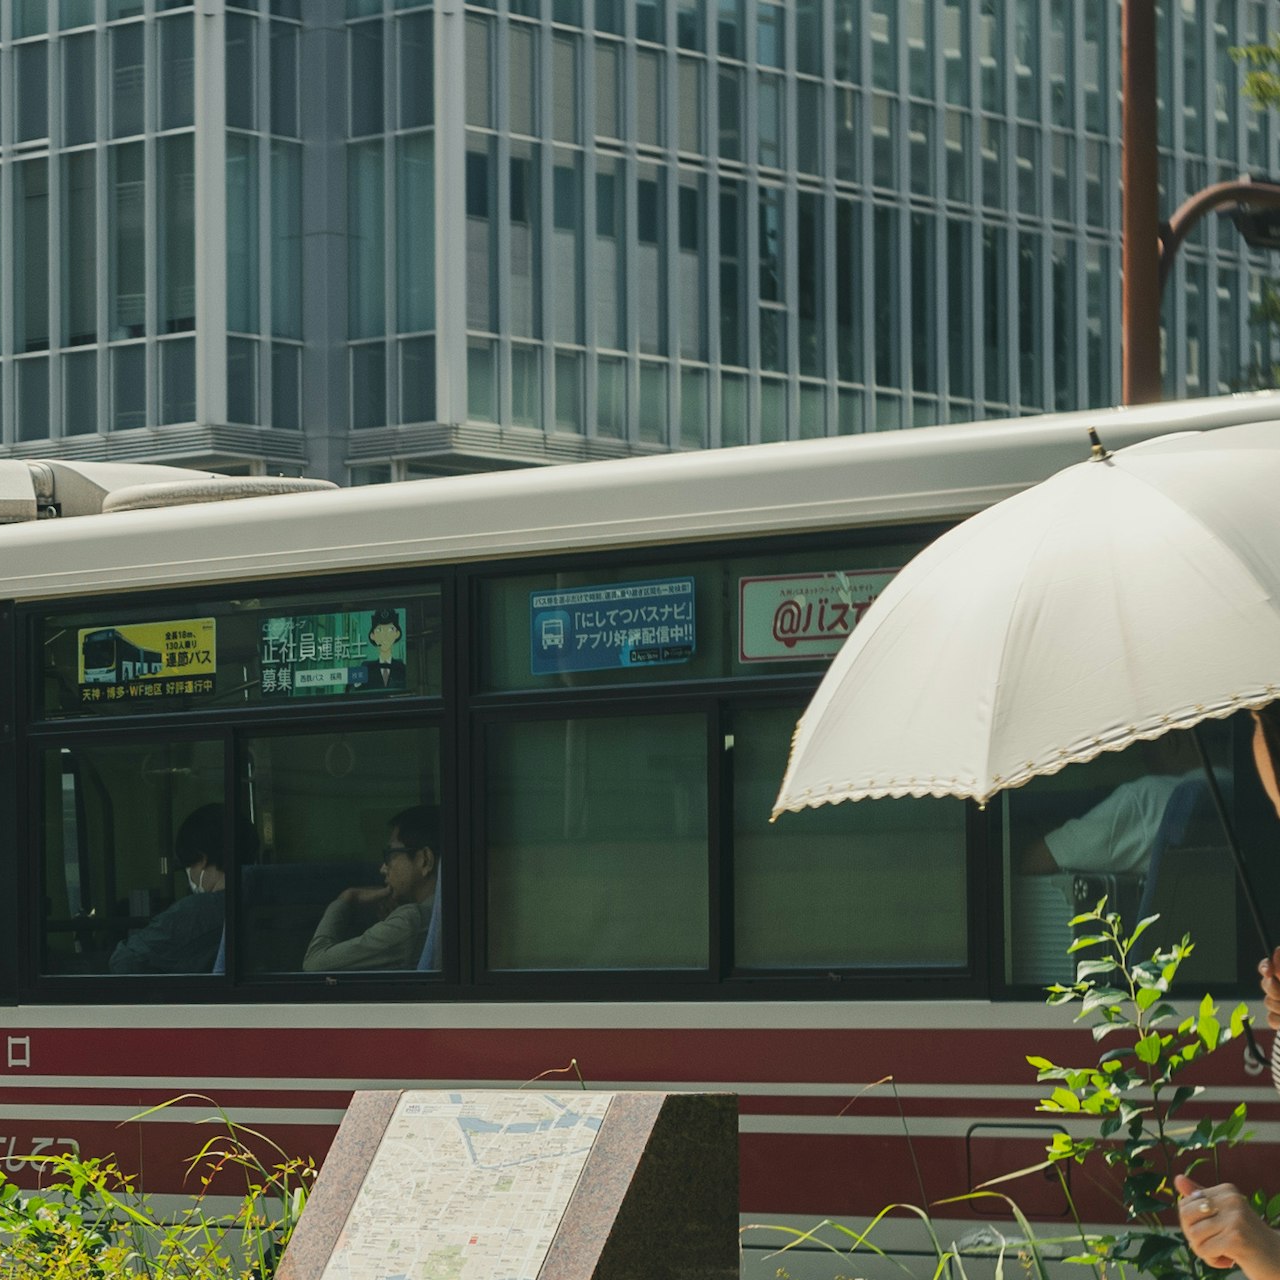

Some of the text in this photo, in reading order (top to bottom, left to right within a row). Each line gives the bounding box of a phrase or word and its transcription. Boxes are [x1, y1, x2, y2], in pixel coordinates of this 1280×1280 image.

[575, 602, 693, 630] 「にしてつバスナビ」
[166, 640, 197, 651] 130人乗り
[262, 633, 367, 664] 正社員運転士
[575, 623, 693, 650] アプリ好評配信中!!
[166, 650, 211, 667] 連節バス
[166, 680, 213, 695] 好評運行中
[262, 667, 292, 693] 募集
